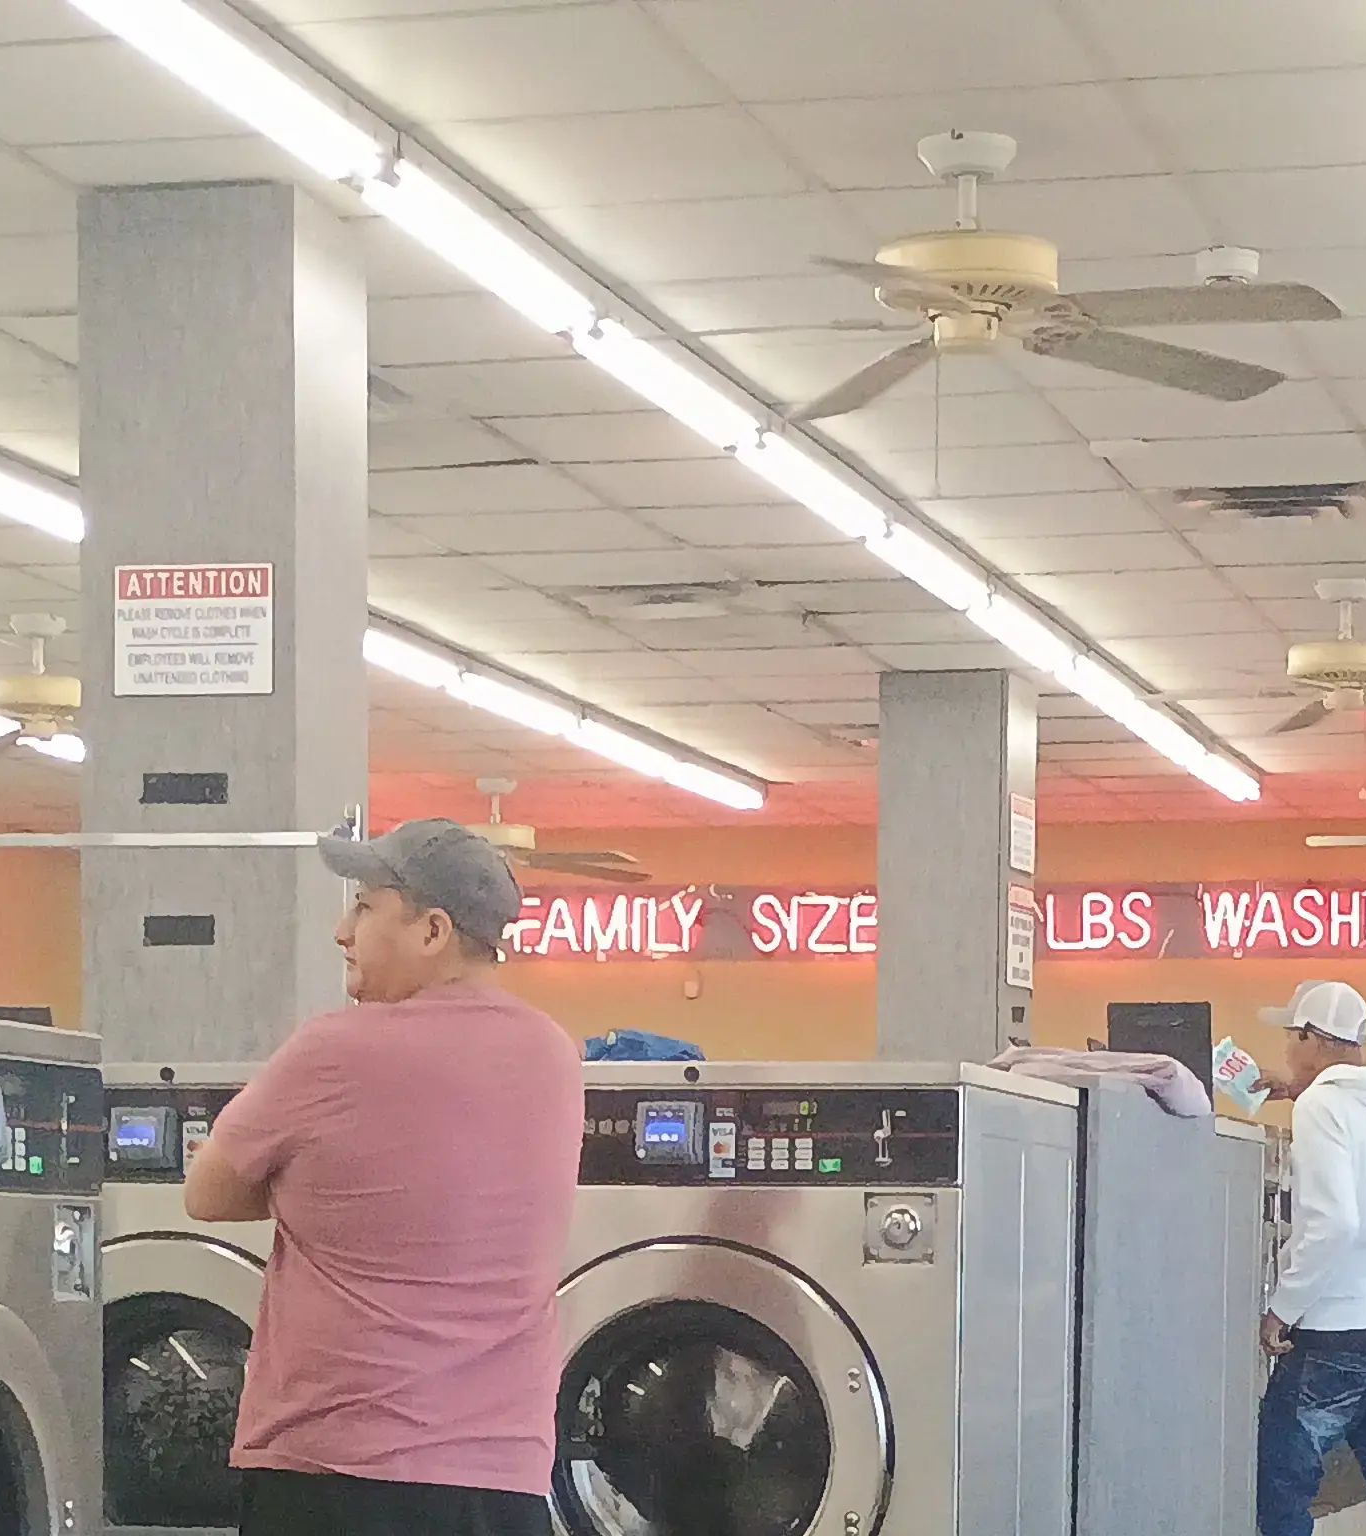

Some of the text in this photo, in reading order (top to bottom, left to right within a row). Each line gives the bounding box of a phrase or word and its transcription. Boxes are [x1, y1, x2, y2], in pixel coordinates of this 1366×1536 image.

[126, 570, 262, 597] ATTENTION
[508, 895, 704, 955] FAMILY
[751, 893, 878, 953] SIZE
[1045, 890, 1153, 950] LBS
